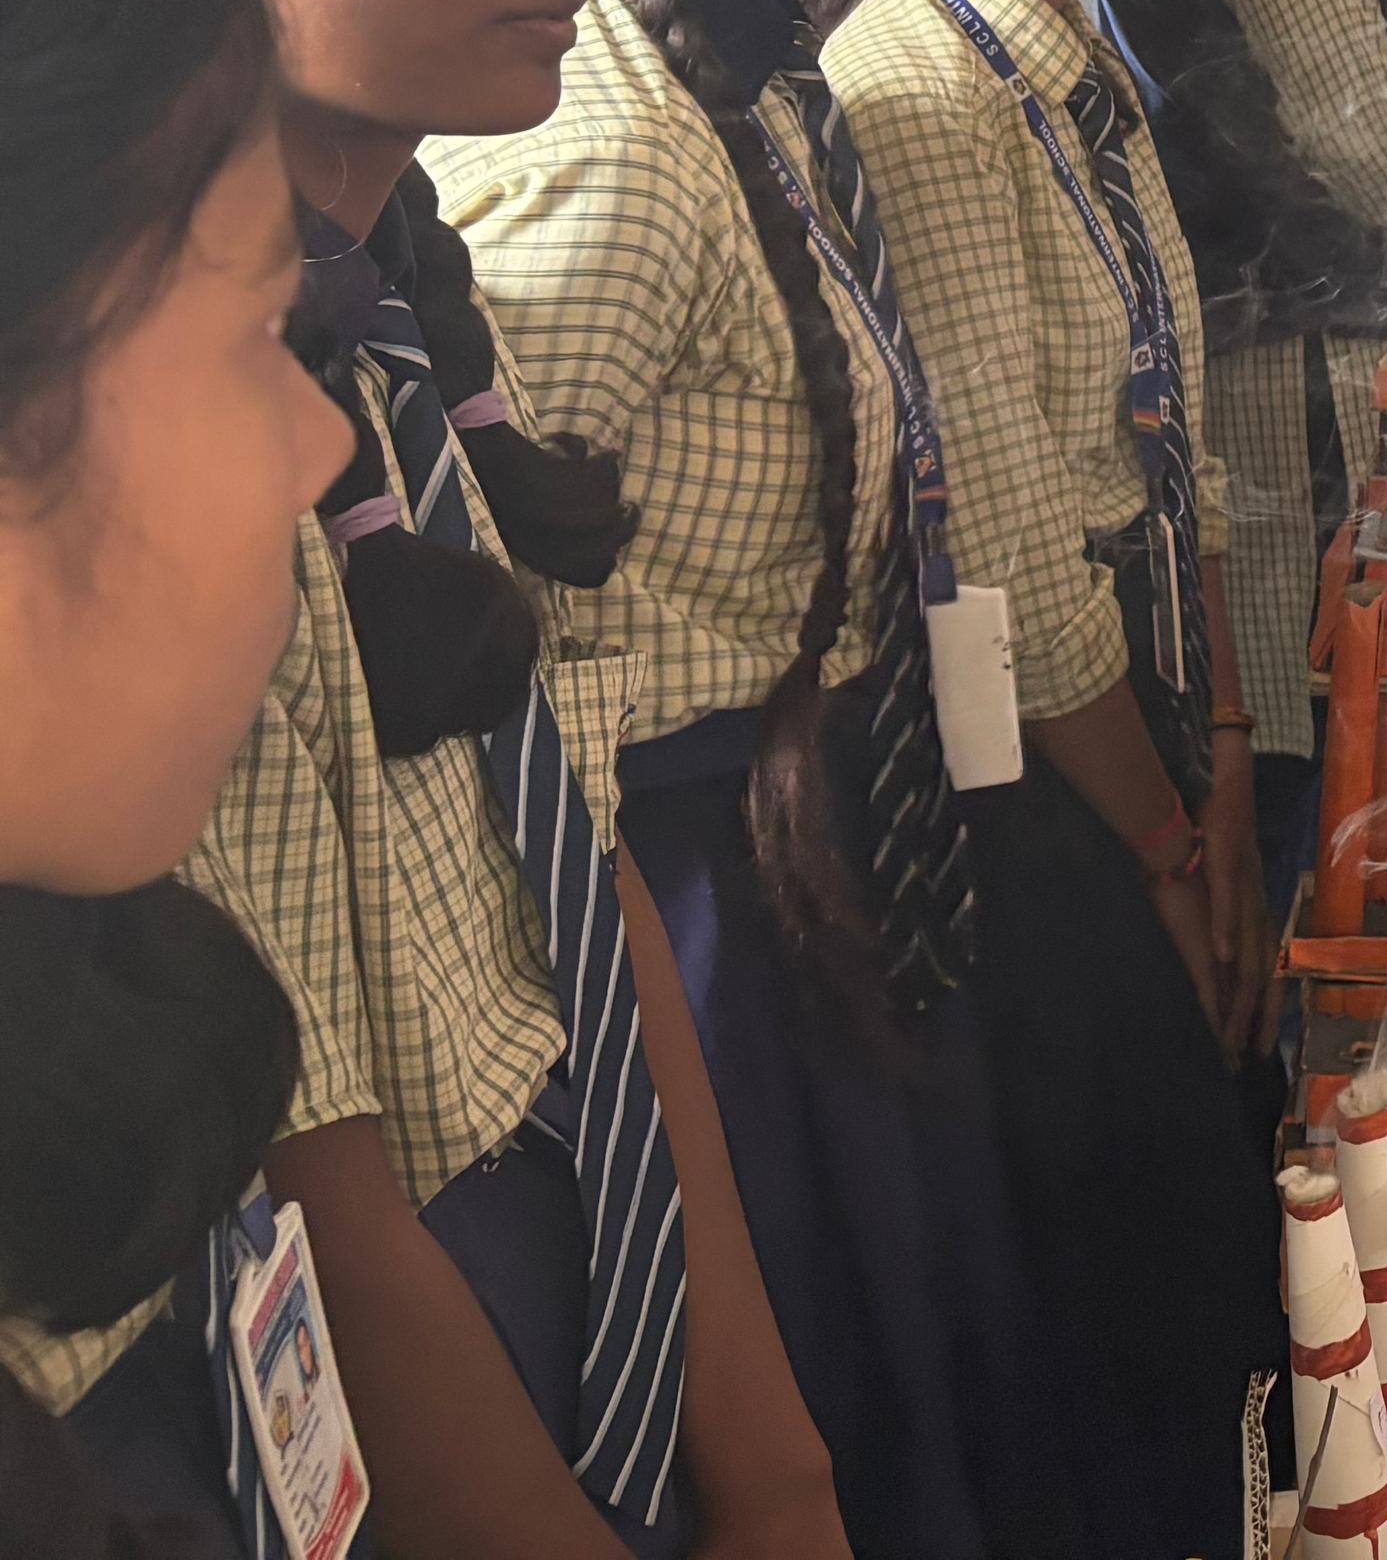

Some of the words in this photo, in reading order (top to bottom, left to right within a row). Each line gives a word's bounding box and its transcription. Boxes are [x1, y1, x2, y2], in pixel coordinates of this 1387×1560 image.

[1040, 119, 1068, 177] SCHOOL
[807, 216, 854, 281] SCHOOL
[1070, 180, 1125, 285] INTERNATIONAL
